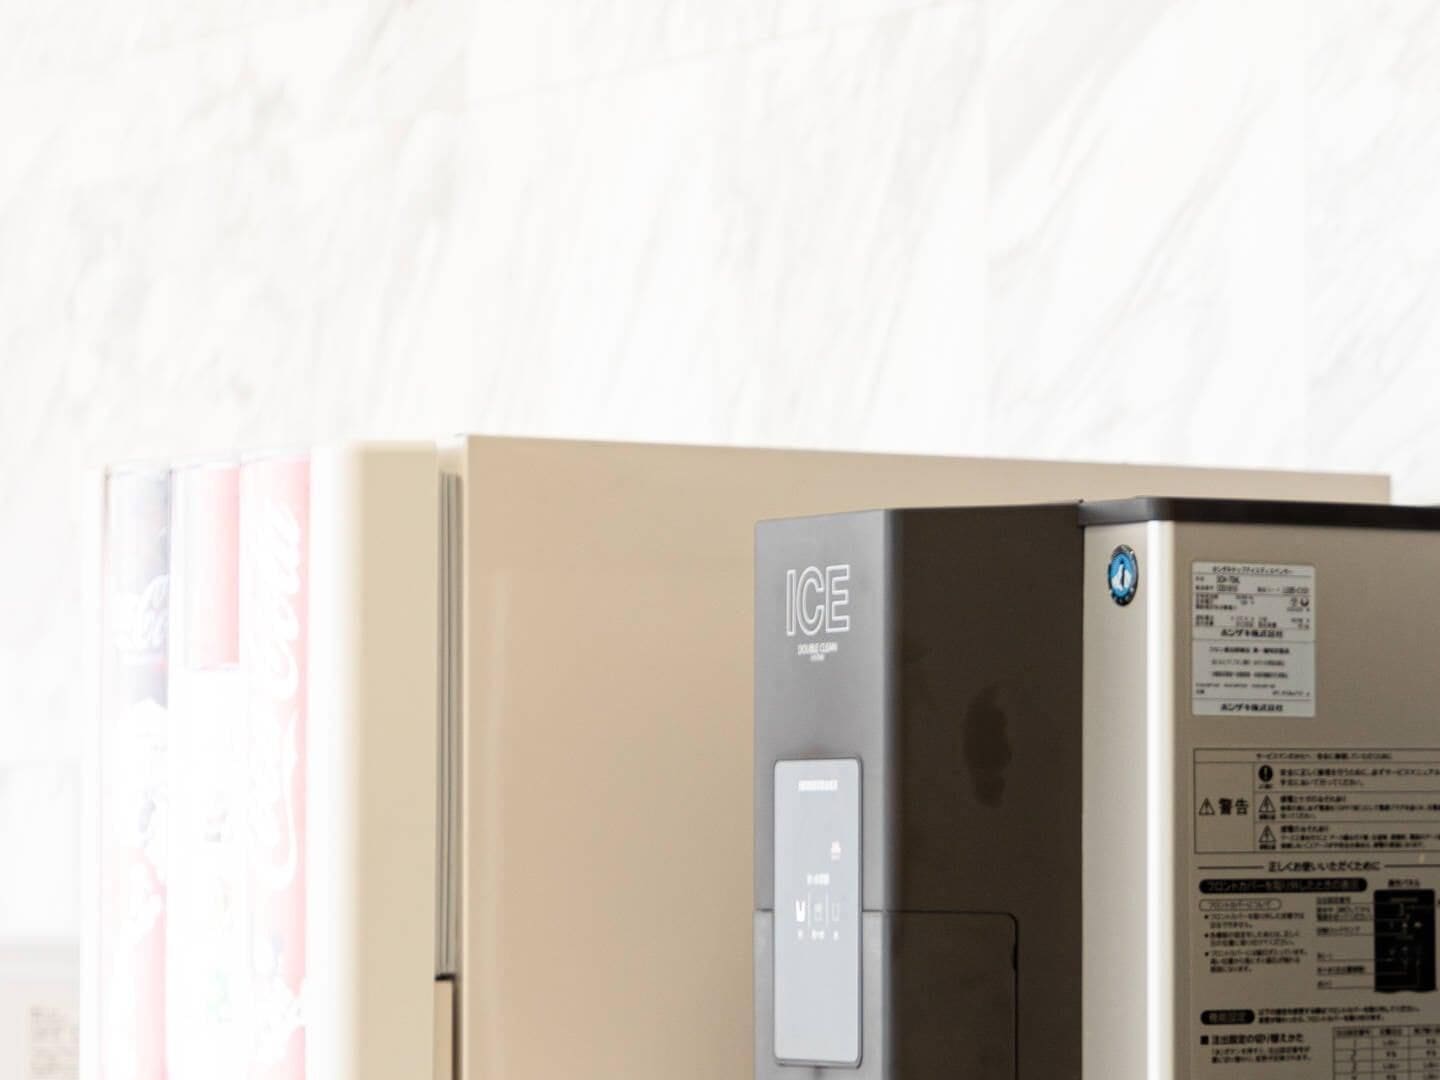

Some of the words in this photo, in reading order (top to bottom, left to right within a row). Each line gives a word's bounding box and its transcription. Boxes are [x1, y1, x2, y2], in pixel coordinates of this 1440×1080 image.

[786, 564, 851, 637] ICE
[1218, 798, 1249, 816] 警告
[1268, 861, 1381, 872] 正しくお使いいただくために
